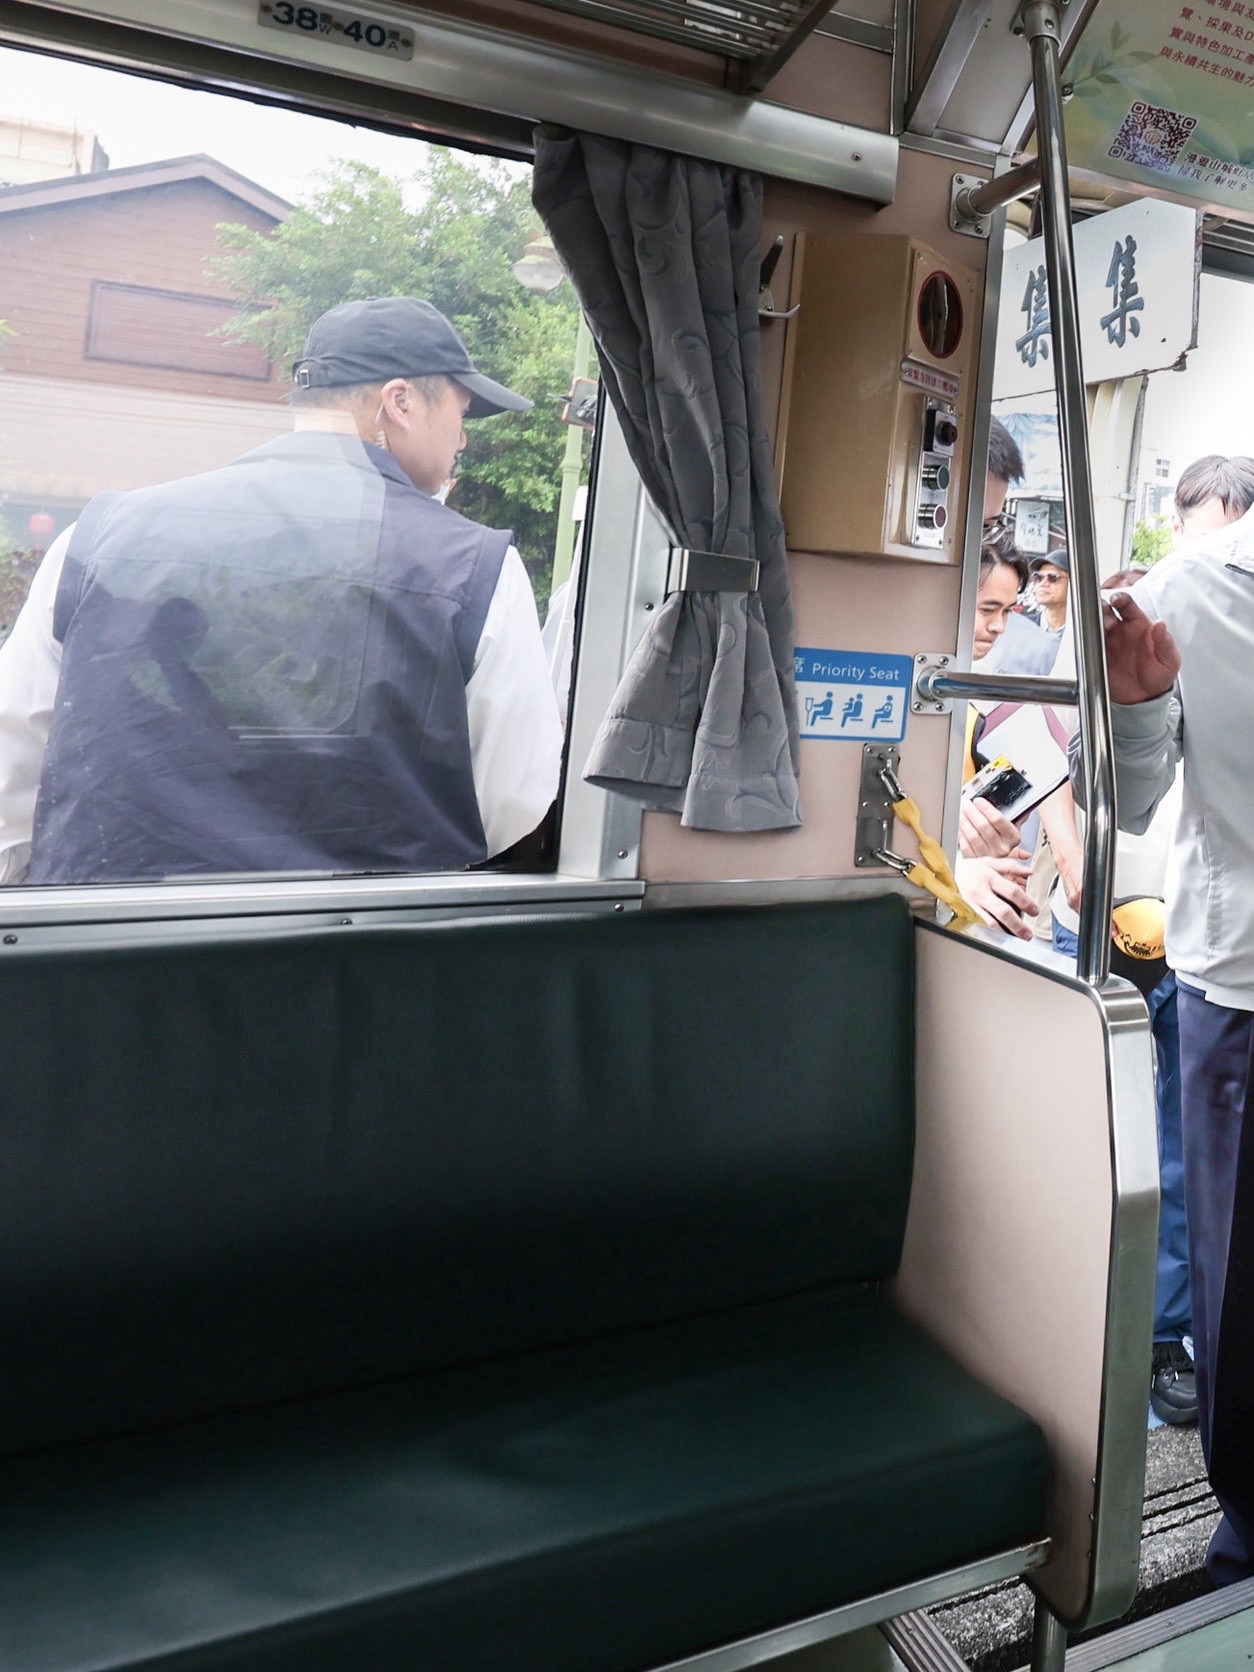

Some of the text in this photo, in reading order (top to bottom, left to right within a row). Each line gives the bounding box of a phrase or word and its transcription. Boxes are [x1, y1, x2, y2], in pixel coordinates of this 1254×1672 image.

[272, 1, 318, 31] 38
[319, 23, 332, 35] W
[343, 20, 386, 47] 40
[388, 41, 399, 51] A
[812, 663, 900, 681] Priority Seat
